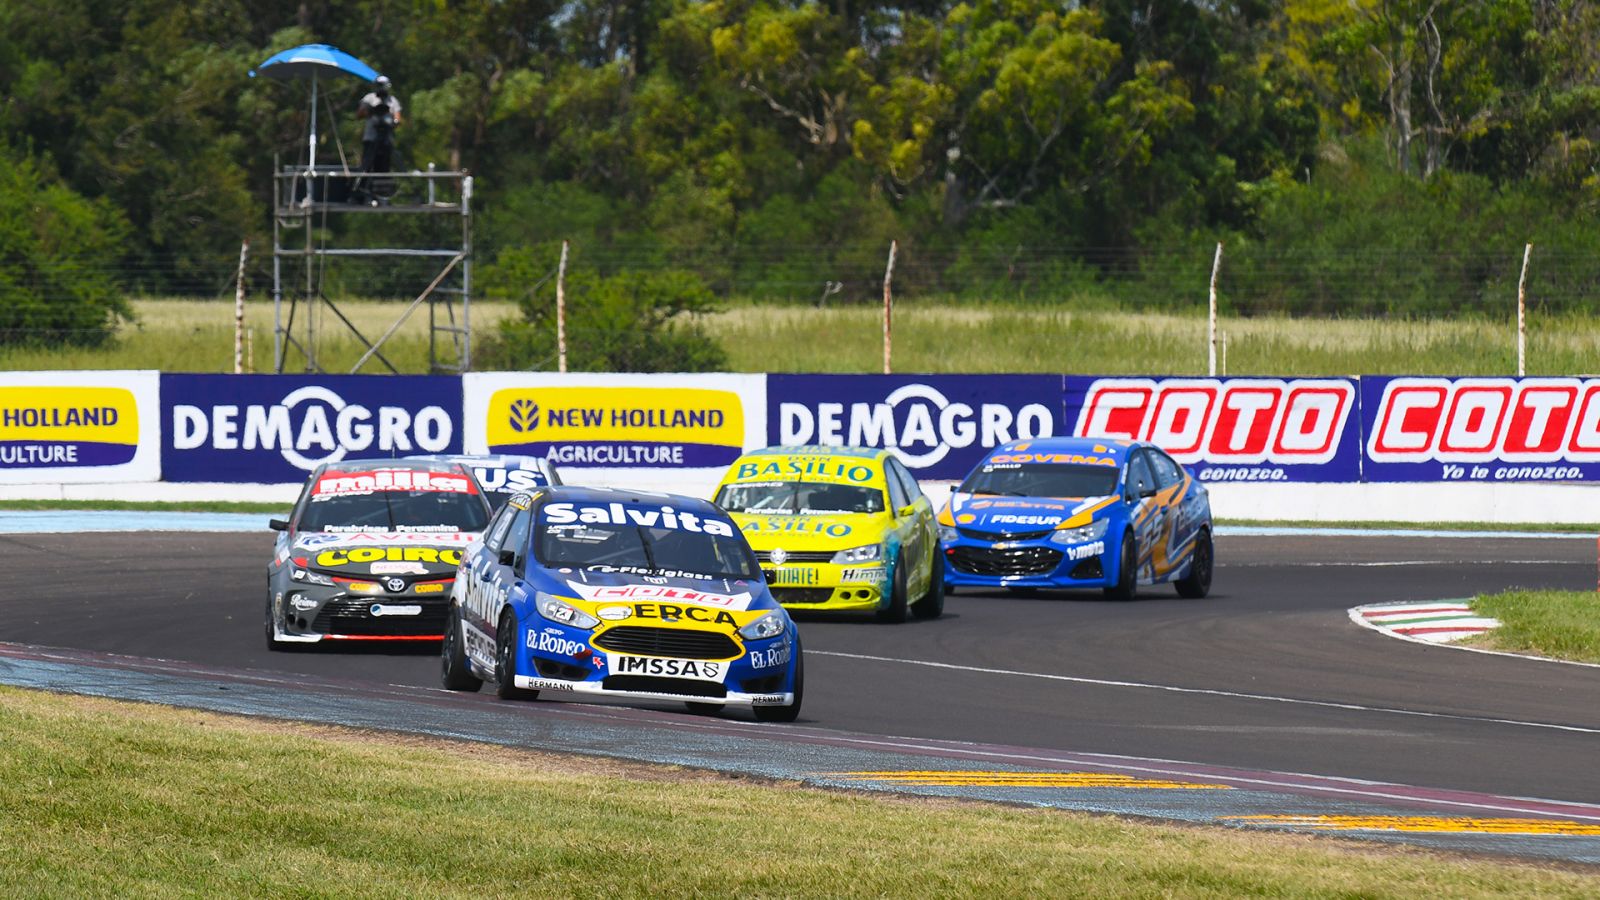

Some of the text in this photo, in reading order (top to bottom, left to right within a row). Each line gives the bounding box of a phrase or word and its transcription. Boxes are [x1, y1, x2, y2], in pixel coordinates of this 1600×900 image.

[3, 407, 119, 427] HOLLAND
[547, 408, 724, 428] NEW HOLLAND
[779, 402, 1053, 449] DEMAGRO
[1073, 378, 1356, 464] COTO
[173, 404, 453, 452] DEMAGRO
[0, 445, 78, 463] ULTURE
[546, 446, 683, 464] AGRICULTURE
[990, 454, 1117, 467] COVEMA
[737, 462, 873, 482] BASILIO
[1199, 467, 1288, 480] conozco.
[1442, 464, 1584, 479] Yo te conozco.
[543, 502, 733, 537] Salvita
[991, 514, 1063, 526] FIDESUR
[742, 521, 852, 538] ASILIO
[526, 629, 586, 656] EL RODEO
[617, 656, 700, 678] IMSSA
[751, 651, 768, 669] EL
[528, 678, 574, 691] HERMANN
